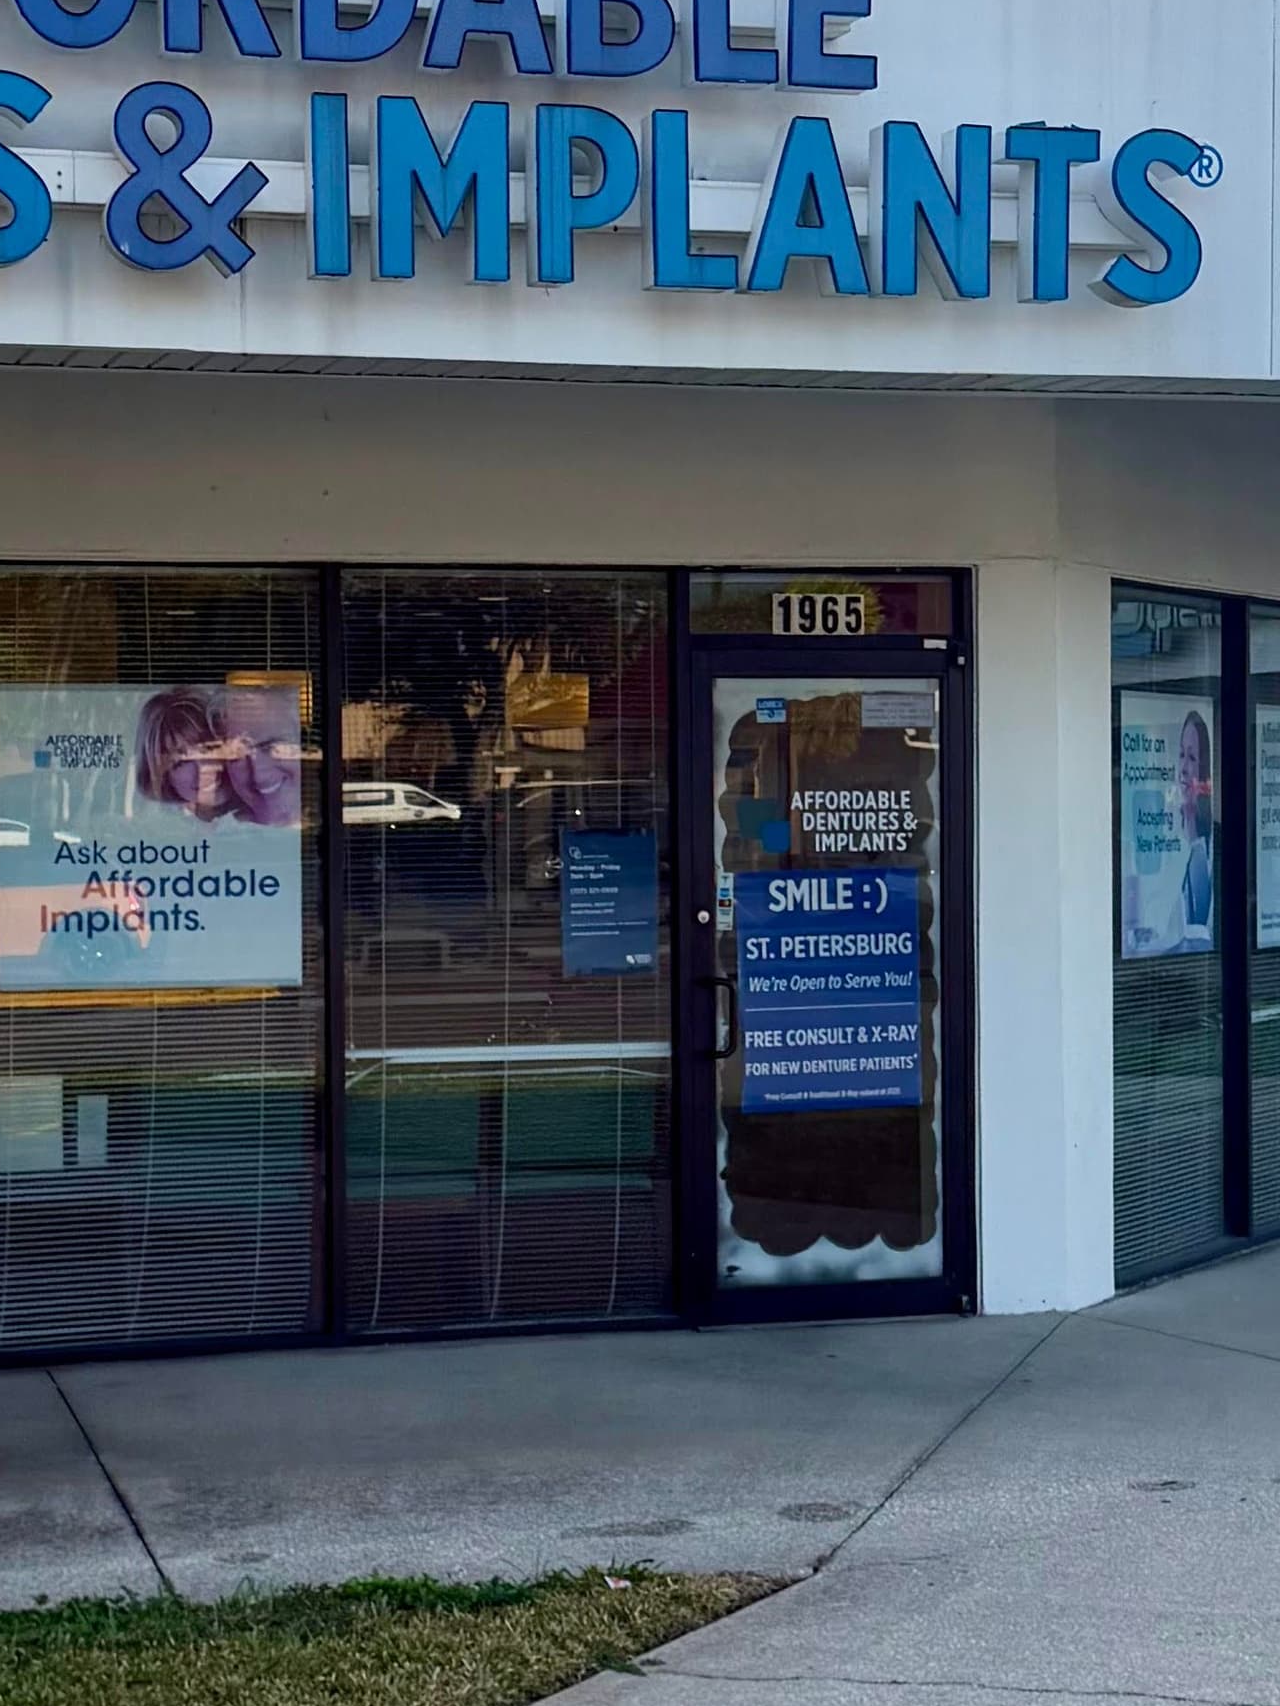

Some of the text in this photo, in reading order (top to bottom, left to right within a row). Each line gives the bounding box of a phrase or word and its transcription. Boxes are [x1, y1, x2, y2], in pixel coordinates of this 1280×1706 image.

[103, 80, 270, 278] &
[776, 595, 863, 633] 1965
[1122, 732, 1140, 753] Call
[1122, 762, 1176, 785] Appointment
[790, 790, 912, 811] AFFORDABLE
[802, 811, 918, 832] DENTURES &
[54, 839, 210, 865] Ask about
[81, 870, 280, 900] Affordable
[768, 878, 854, 912] SMILE
[39, 904, 206, 940] Implants.
[745, 933, 912, 960] ST. PETERSBURG
[748, 971, 913, 993] We're Open to Serve You!
[745, 1024, 918, 1049] FREE CONSULT & X-RAY
[745, 1061, 770, 1077] FOR
[772, 1060, 800, 1075] NEW
[803, 1058, 858, 1074] DENTURE
